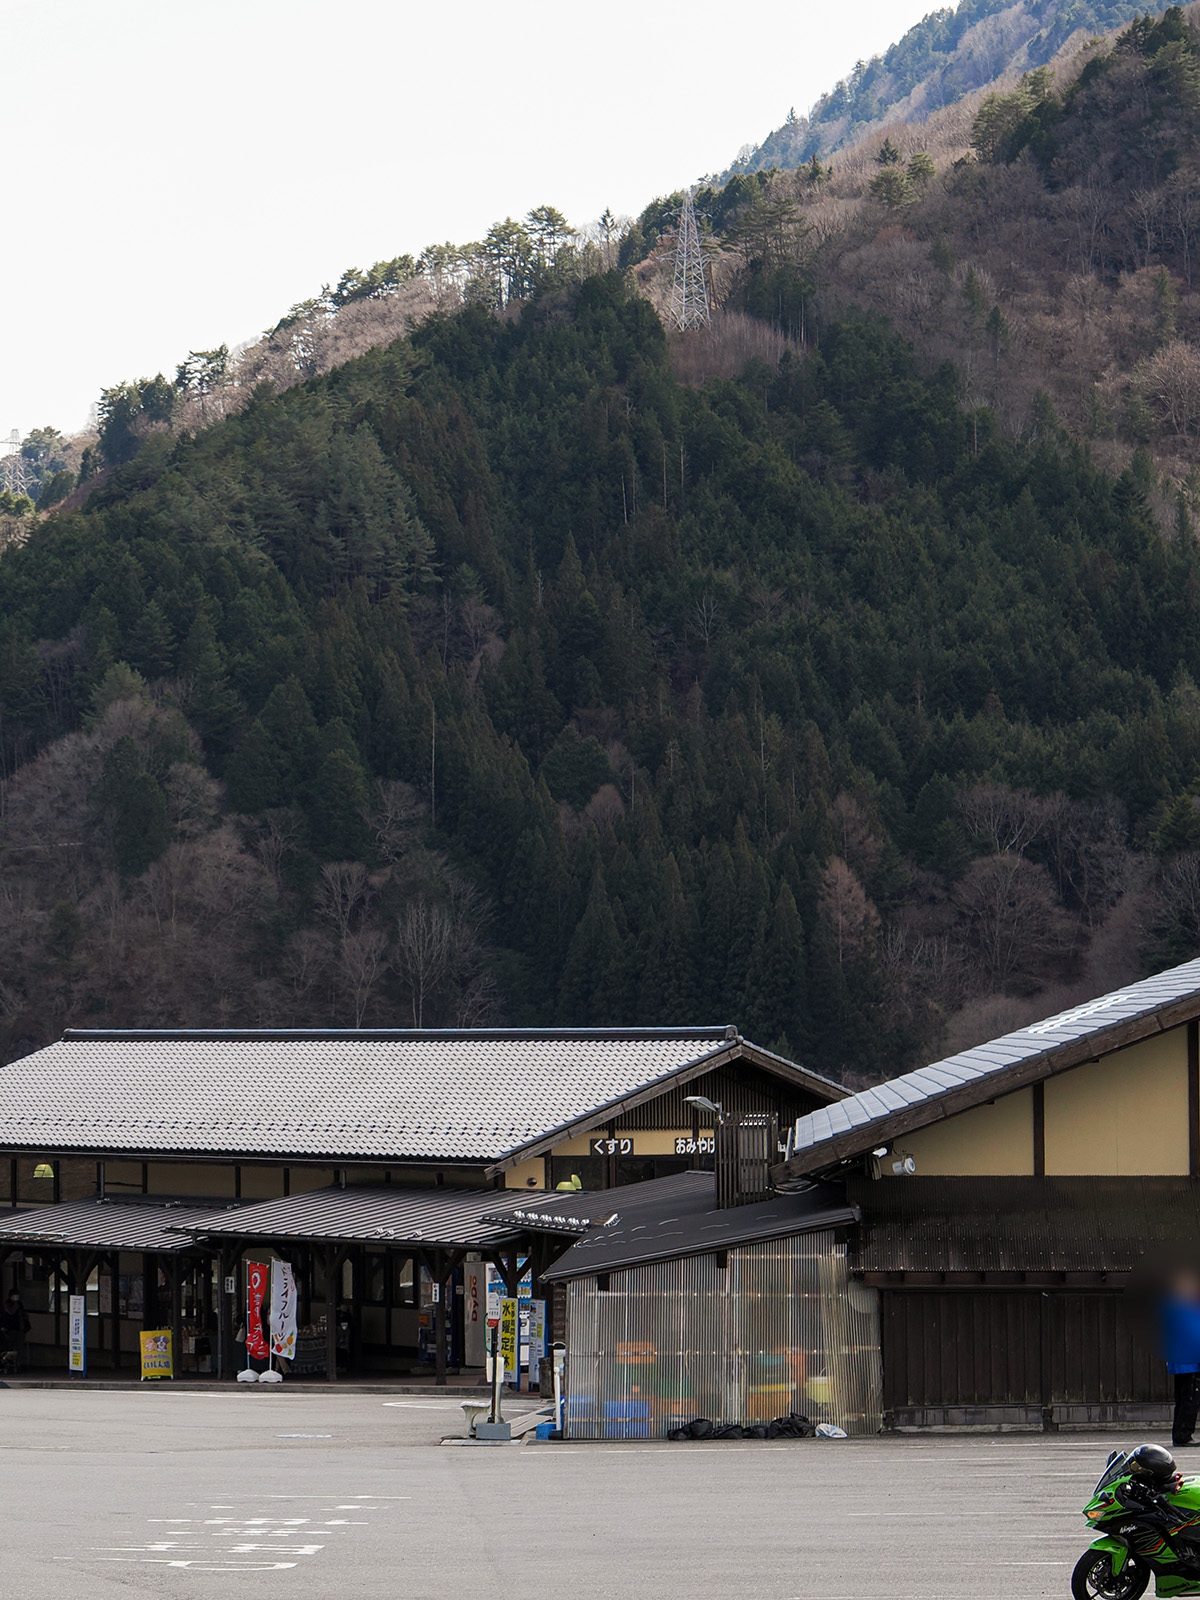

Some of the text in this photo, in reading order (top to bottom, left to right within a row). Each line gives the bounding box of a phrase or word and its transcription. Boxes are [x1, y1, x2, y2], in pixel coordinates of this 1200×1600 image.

[593, 1138, 632, 1155] くすり
[1119, 1524, 1138, 1534] Ninja
